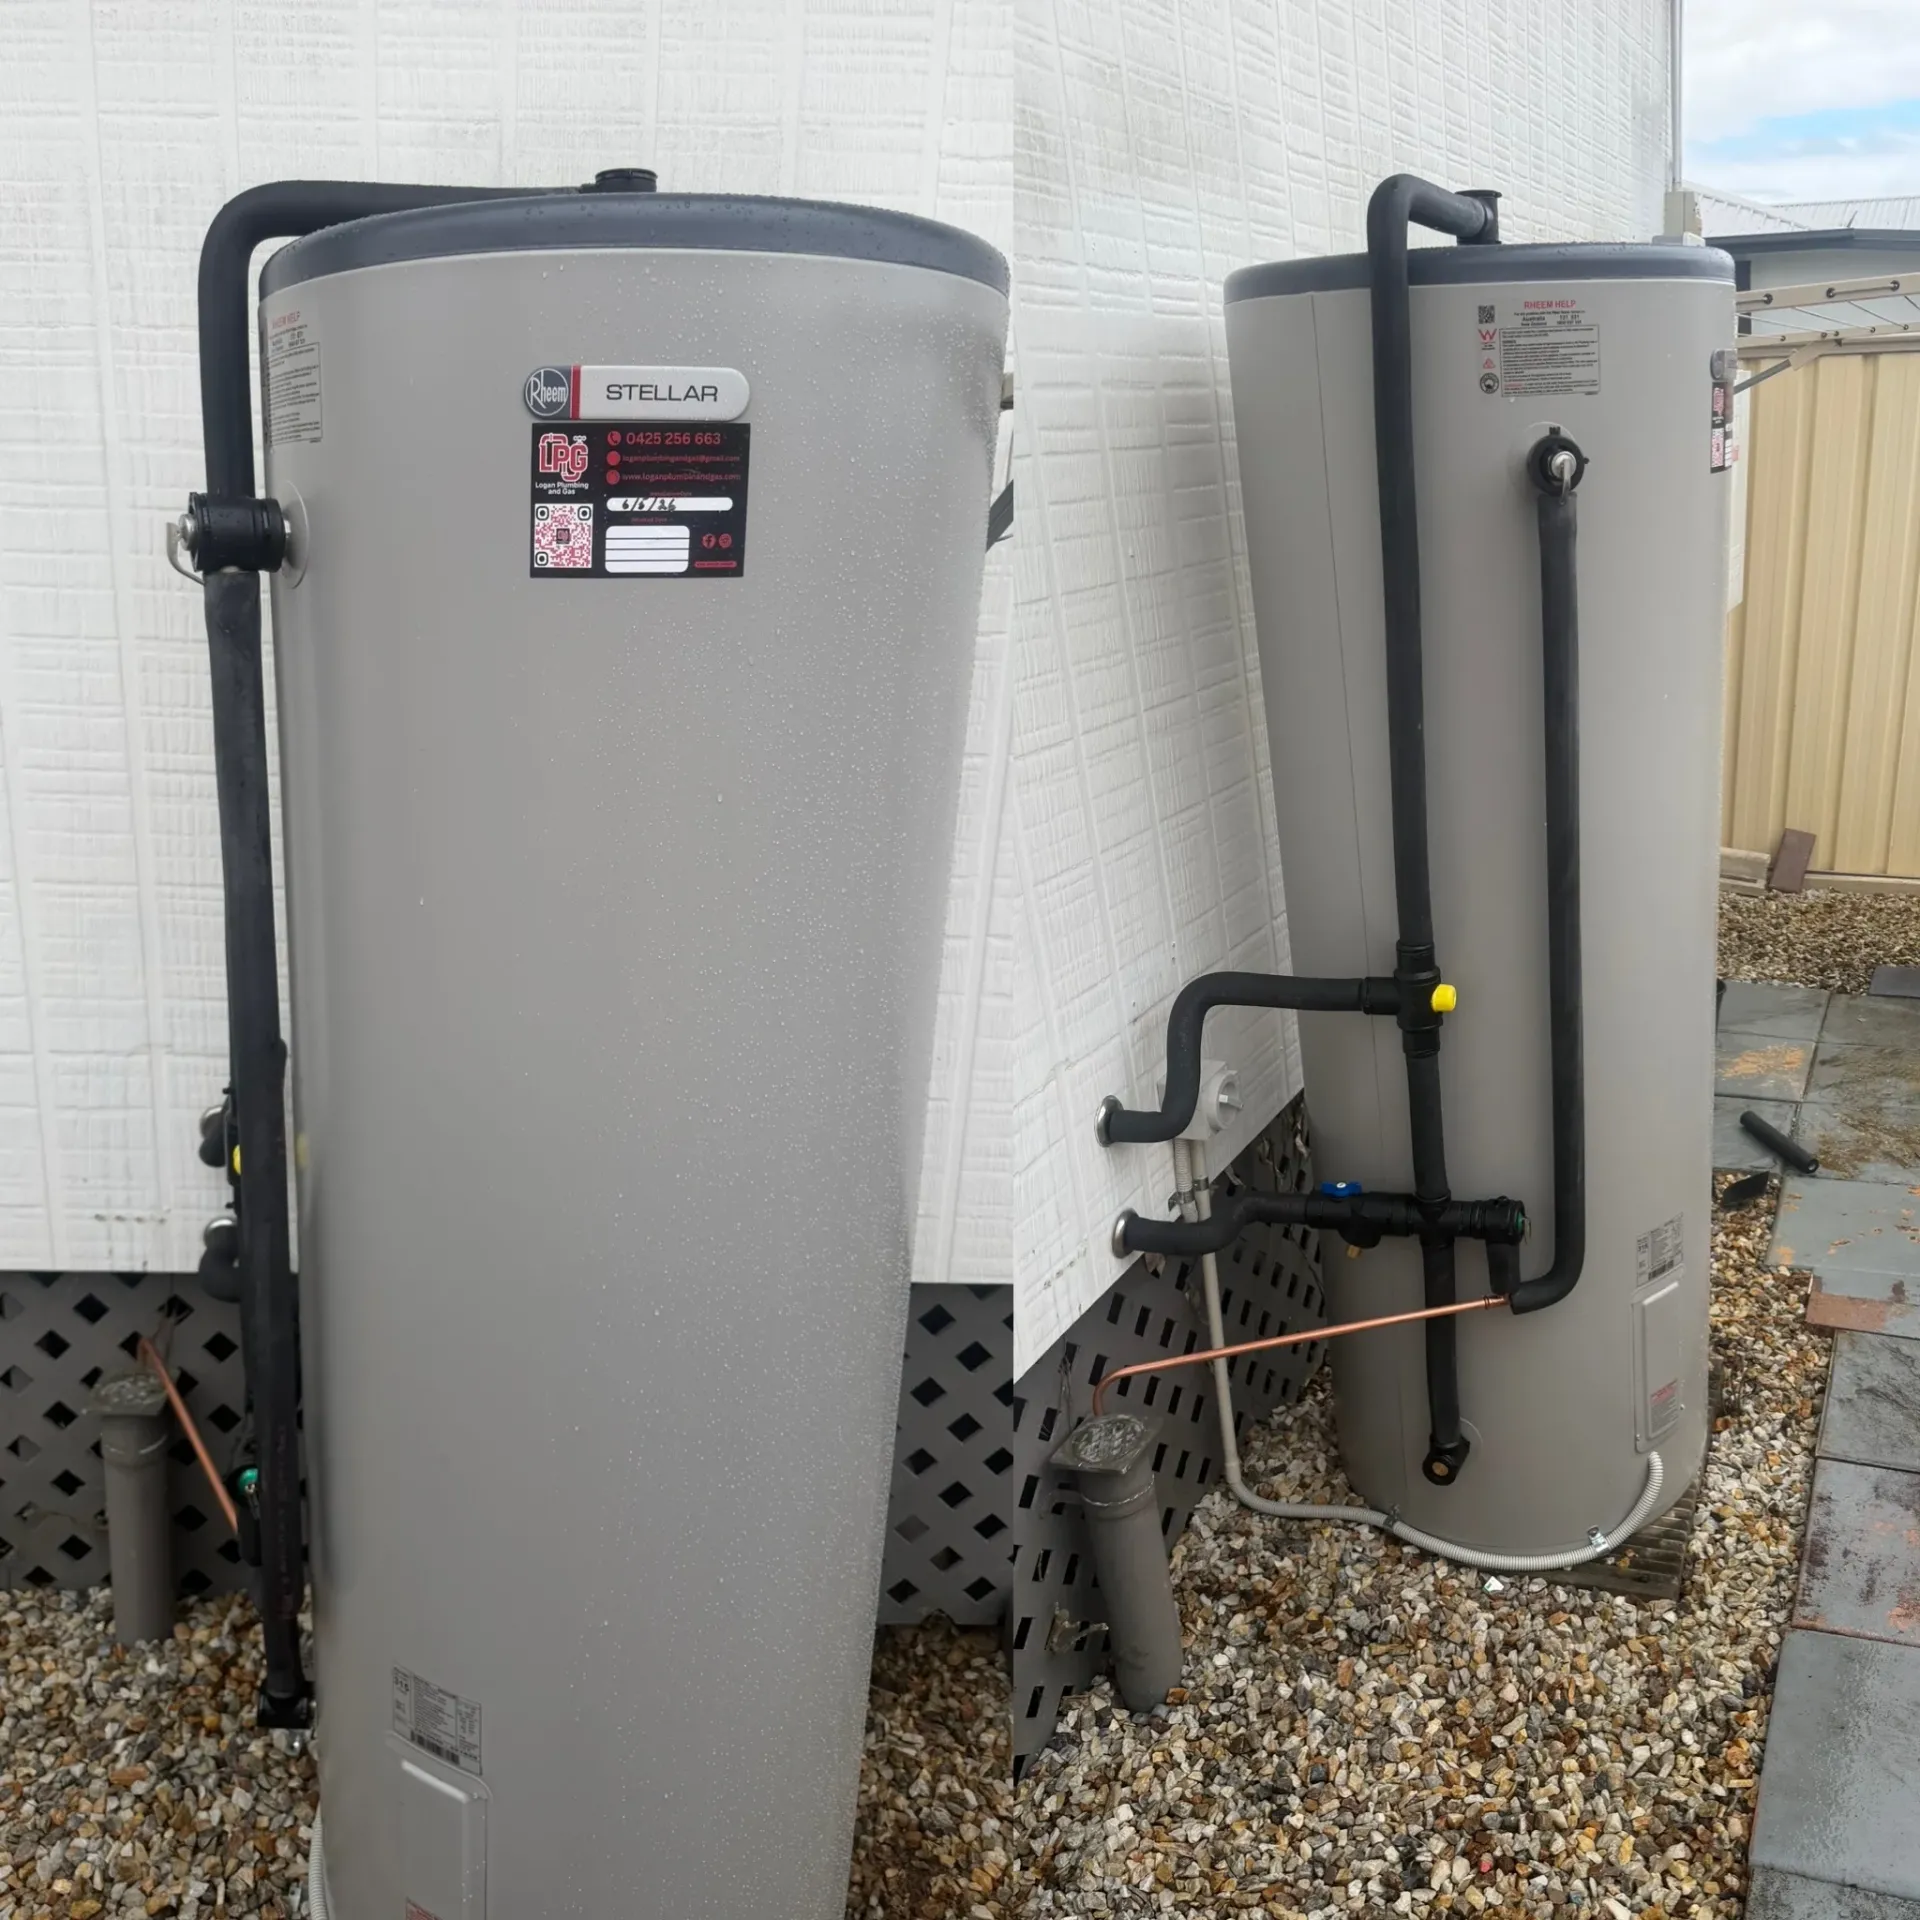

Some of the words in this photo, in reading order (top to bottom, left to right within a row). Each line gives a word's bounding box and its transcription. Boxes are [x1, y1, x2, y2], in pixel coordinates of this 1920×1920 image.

[1524, 300, 1553, 309] RHEEM
[1555, 299, 1577, 308] HELP
[530, 370, 567, 409] Rheem
[606, 384, 719, 402] STELLAR
[626, 432, 662, 445] 0425
[664, 432, 691, 445] 256
[694, 432, 721, 445] 663
[539, 439, 588, 476] LPG
[556, 482, 589, 490] Plumbing
